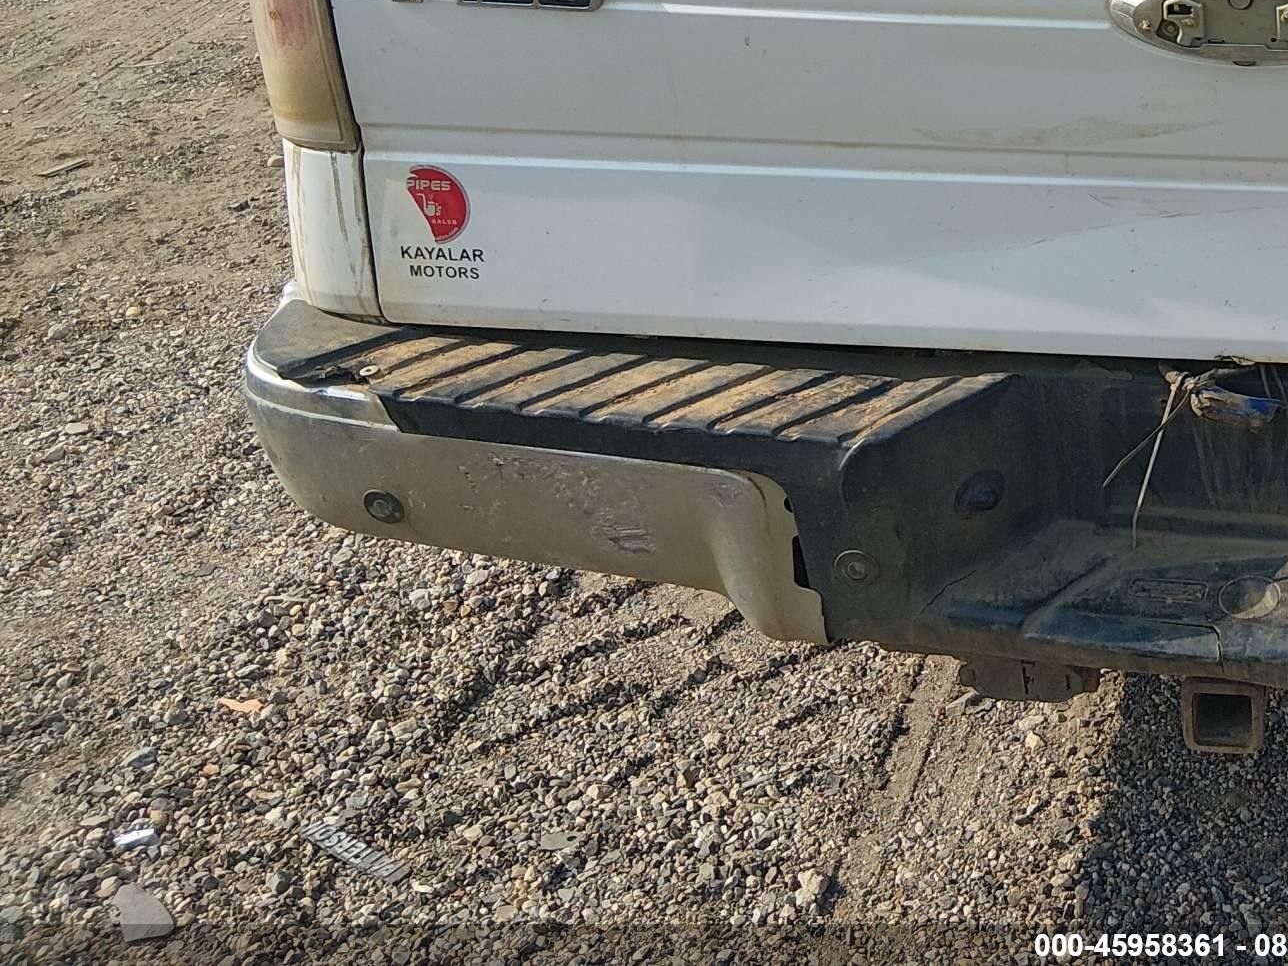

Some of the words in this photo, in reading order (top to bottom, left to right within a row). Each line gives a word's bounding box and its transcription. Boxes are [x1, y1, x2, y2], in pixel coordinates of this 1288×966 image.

[407, 179, 451, 191] PIPES
[400, 245, 485, 263] KAYALAR
[409, 265, 480, 280] MOTORS
